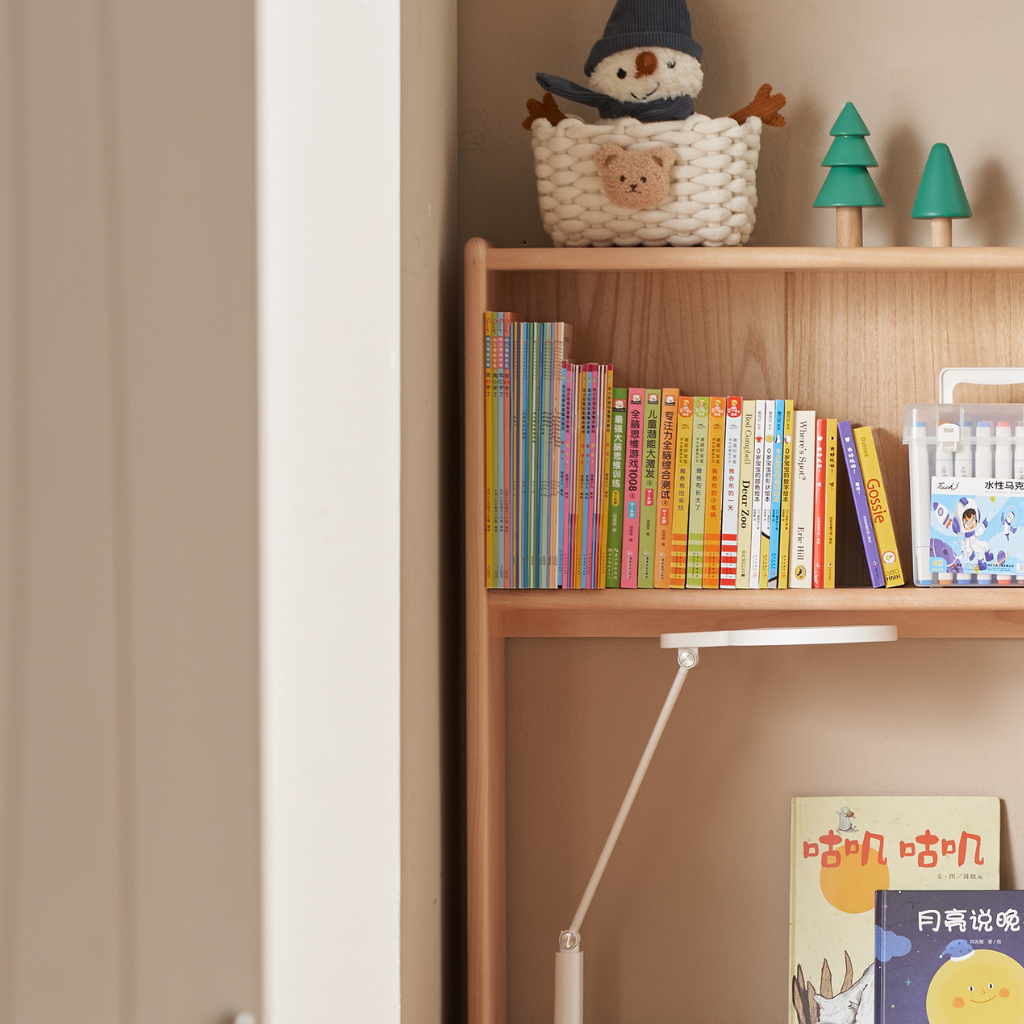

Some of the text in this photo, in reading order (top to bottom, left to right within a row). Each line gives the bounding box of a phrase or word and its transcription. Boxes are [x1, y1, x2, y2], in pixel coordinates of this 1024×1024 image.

[611, 415, 623, 488] 最强大脑思维训练
[628, 409, 641, 492] 全脑思维游戏1008
[645, 410, 658, 479] 儿童潜能大激发
[660, 411, 675, 499] 专注力全脑综合测试
[744, 430, 752, 465] Campbell
[797, 421, 807, 481] Where's Spot?
[678, 468, 686, 511] 雅各布出去玩
[727, 468, 735, 511] 雅各布的一天
[740, 480, 751, 529] Dear Zoo
[867, 478, 887, 523] Gossie
[886, 574, 900, 582] HMH
[803, 829, 984, 868] 咕叽 咕叽
